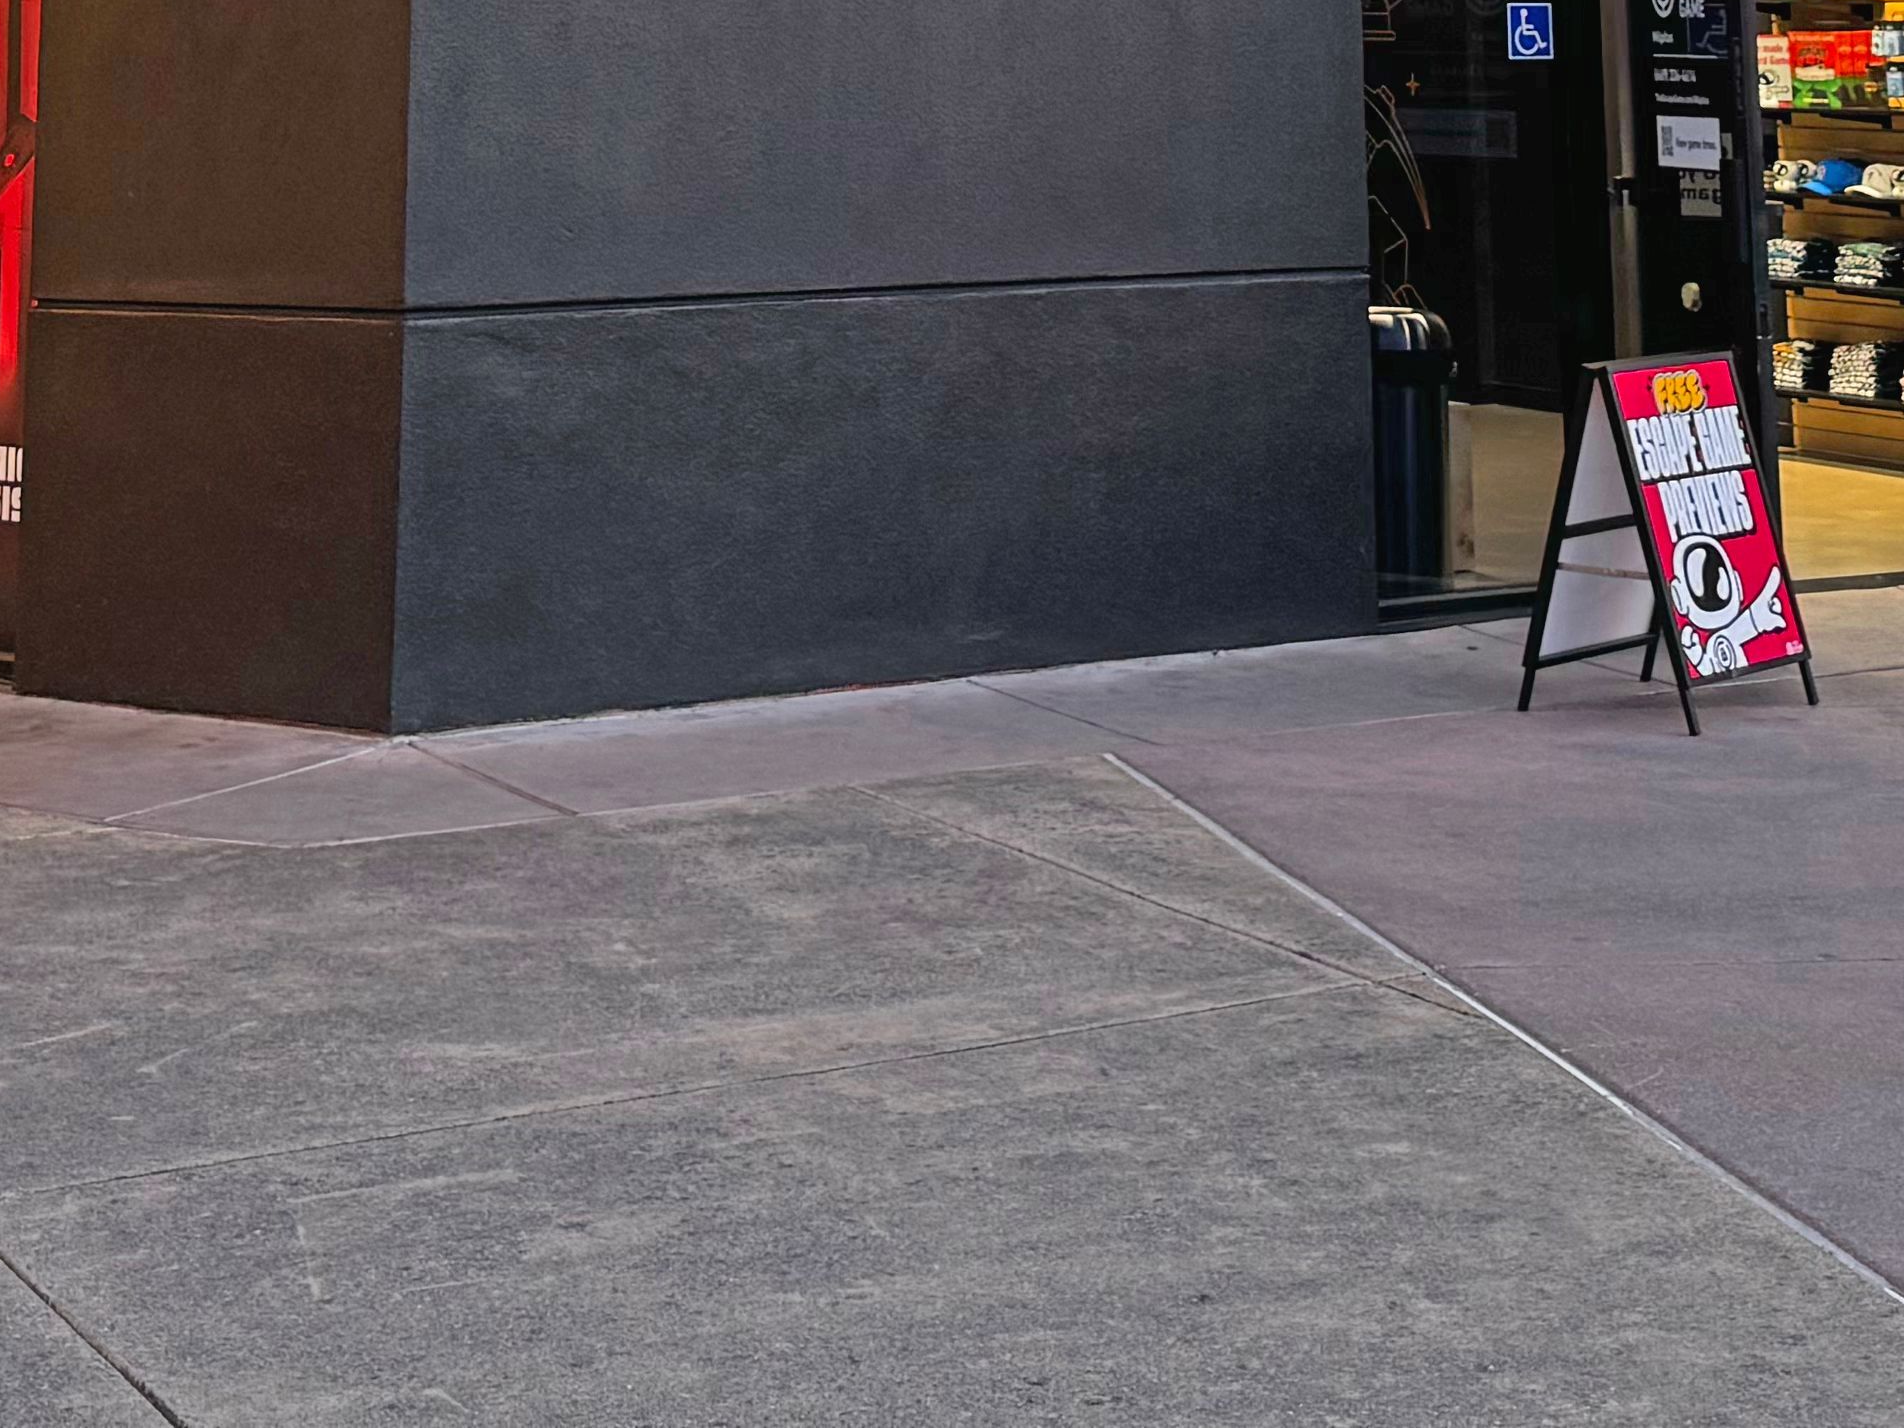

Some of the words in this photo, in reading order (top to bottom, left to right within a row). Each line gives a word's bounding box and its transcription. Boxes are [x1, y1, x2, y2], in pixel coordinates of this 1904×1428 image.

[1653, 370, 1707, 414] FREE
[1627, 415, 1703, 481] ESCAPE
[1695, 406, 1751, 470] GAME
[1659, 470, 1753, 543] PREVIEWS
